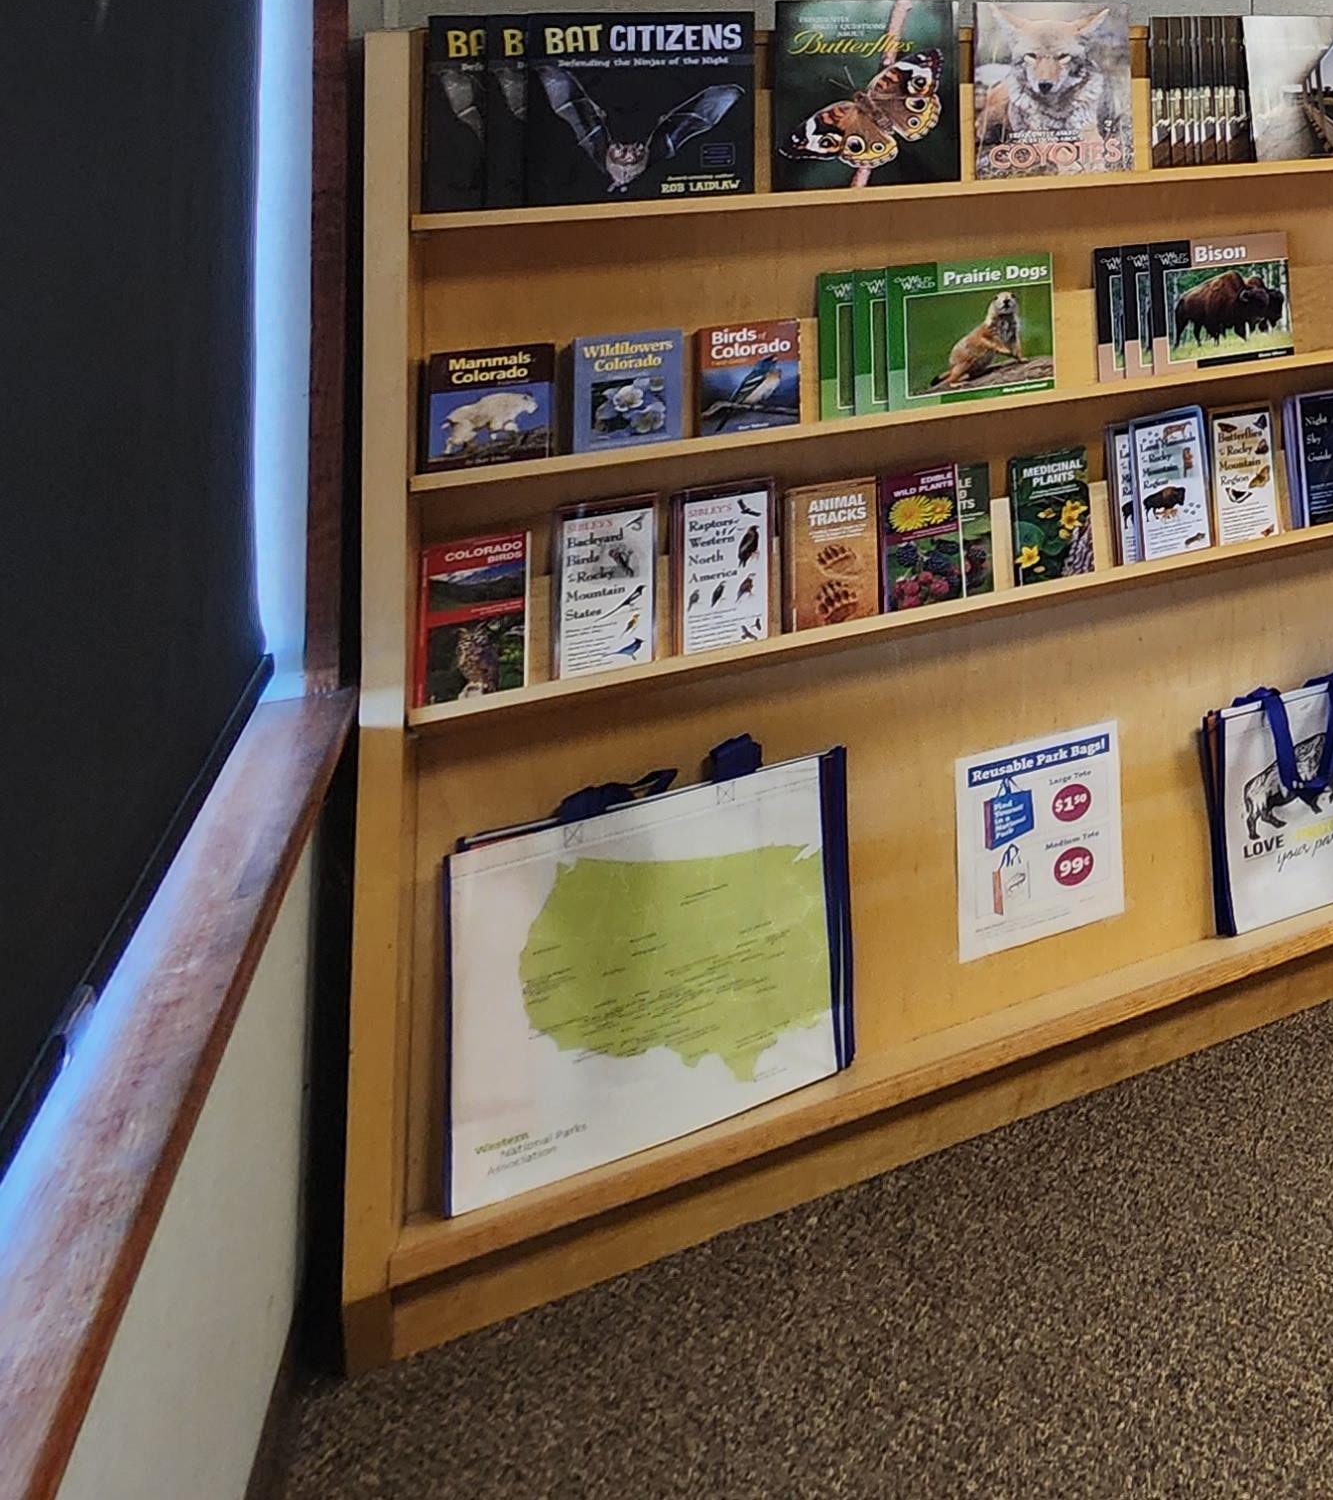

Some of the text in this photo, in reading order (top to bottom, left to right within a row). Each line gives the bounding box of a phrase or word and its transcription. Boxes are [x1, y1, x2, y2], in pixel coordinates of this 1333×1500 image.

[446, 28, 486, 58] BA
[544, 24, 603, 55] BAT
[609, 23, 743, 51] CITIZENS
[787, 30, 916, 59] Butterflies
[558, 56, 729, 69] Defending the Ninjas of the Night
[990, 137, 1123, 169] COYOTES
[661, 179, 741, 194] ROB LAIDLAW
[1194, 245, 1247, 262] Bison
[943, 264, 1049, 287] Prairie Dogs
[711, 327, 758, 346] Birds
[583, 340, 674, 358] Wildflowers
[711, 337, 792, 360] Colorado
[448, 351, 532, 371] Mammals
[593, 353, 662, 372] Colorado
[451, 365, 529, 385] Colorado
[1304, 413, 1328, 427] Night
[1217, 426, 1263, 443] Butterflies
[1306, 432, 1321, 445] Sky
[1148, 450, 1173, 463] Rocky
[1227, 441, 1253, 456] Rocky
[1307, 448, 1333, 462] Guide
[1022, 459, 1084, 479] MEDICINAL
[1218, 457, 1262, 471] Mountain
[920, 471, 953, 485] EDIBLE
[1032, 470, 1076, 488] PLANTS
[1220, 474, 1250, 486] Region
[893, 479, 954, 498] WILD PLANTS
[807, 493, 867, 513] ANIMAL
[807, 506, 867, 526] TRACKS
[688, 518, 735, 533] Raptors
[566, 527, 624, 549] Backyard
[689, 535, 736, 548] Western
[444, 540, 523, 562] COLORADO
[487, 550, 523, 564] BIRDS
[566, 550, 600, 567] Birds
[688, 549, 724, 567] North
[576, 566, 615, 583] Rocky
[688, 569, 738, 584] America
[566, 584, 626, 603] Mountain
[564, 608, 602, 622] States
[972, 737, 1106, 782] Reusable Park Bags!
[1049, 769, 1092, 786] Large Tote
[1045, 831, 1100, 850] Medium Tote
[1243, 834, 1285, 859] LOVE
[1277, 843, 1312, 873] your
[474, 1131, 529, 1155] Western
[501, 1123, 588, 1157] National Parks
